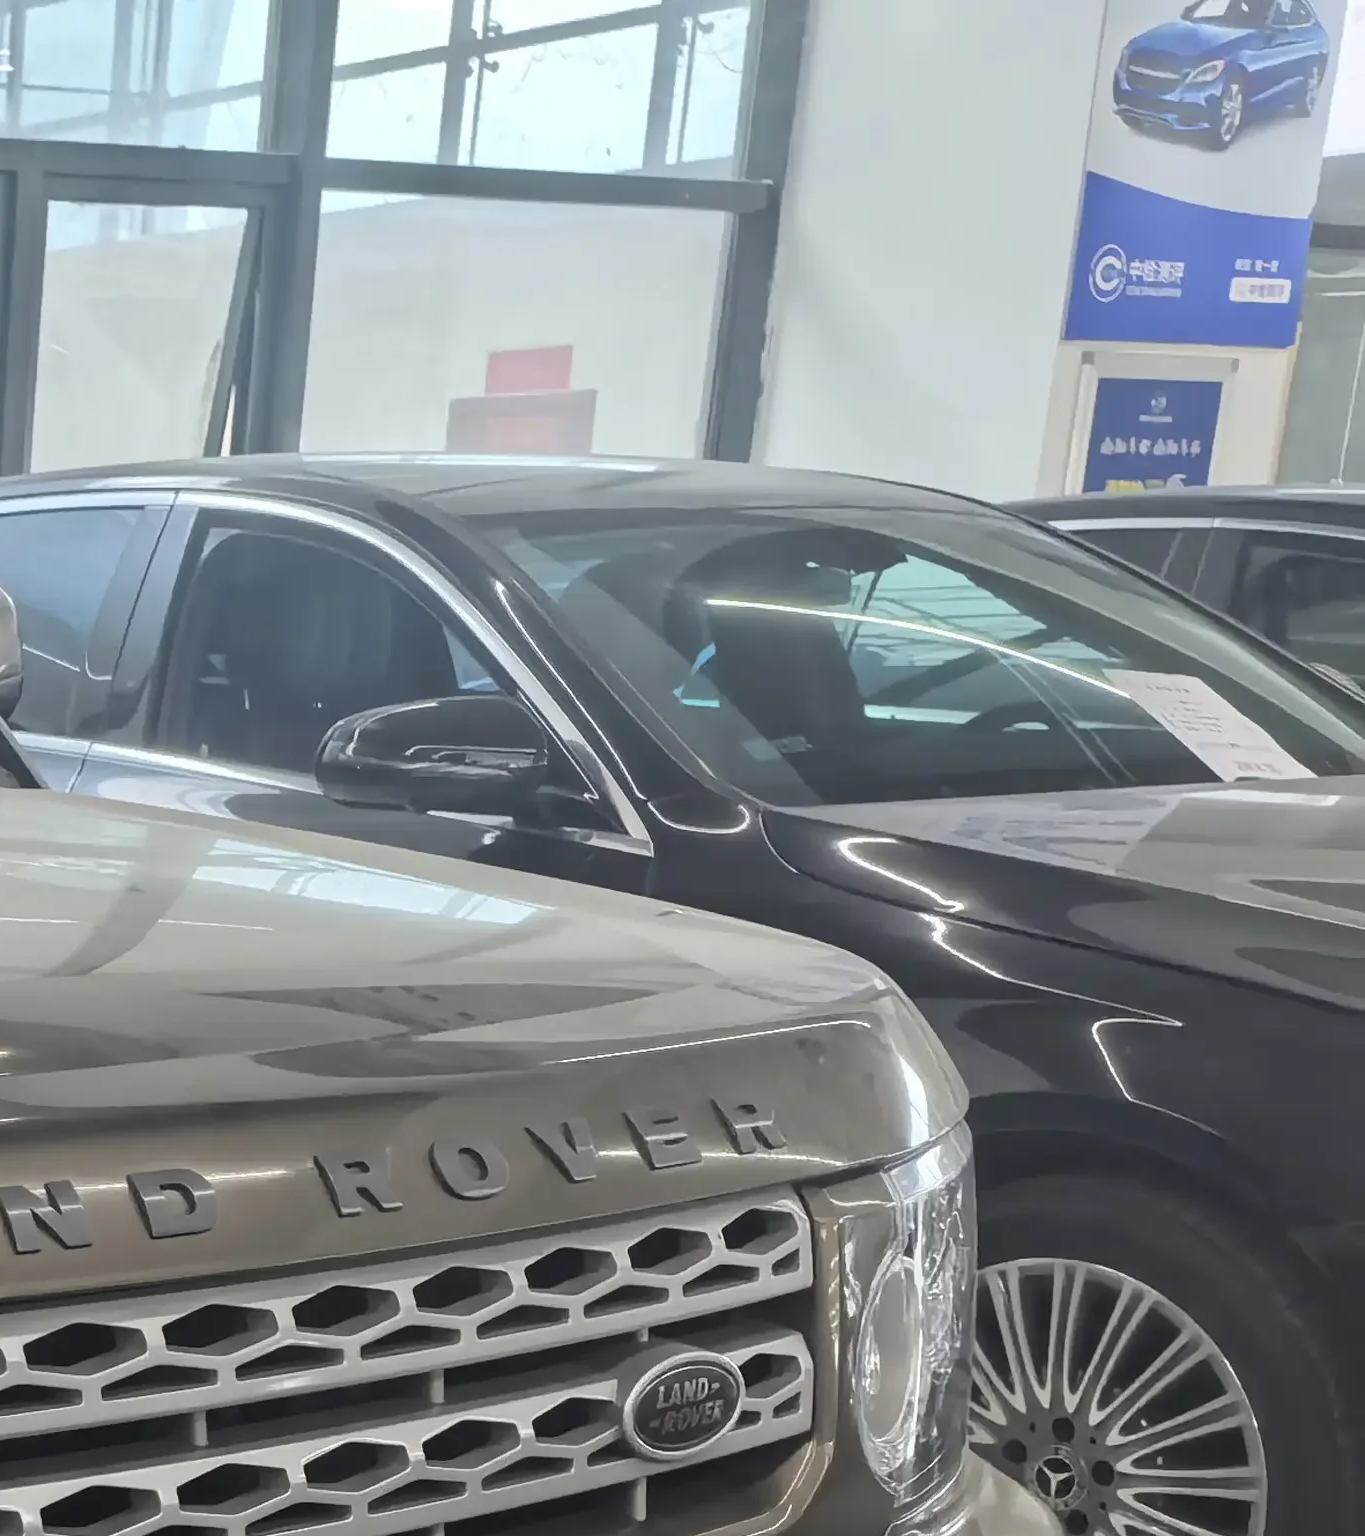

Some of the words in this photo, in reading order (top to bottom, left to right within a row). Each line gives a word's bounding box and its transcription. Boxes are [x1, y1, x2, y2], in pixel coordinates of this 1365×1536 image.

[312, 1097, 788, 1218] ROVER
[656, 1377, 709, 1409] LAND
[661, 1399, 725, 1435] ROVER
